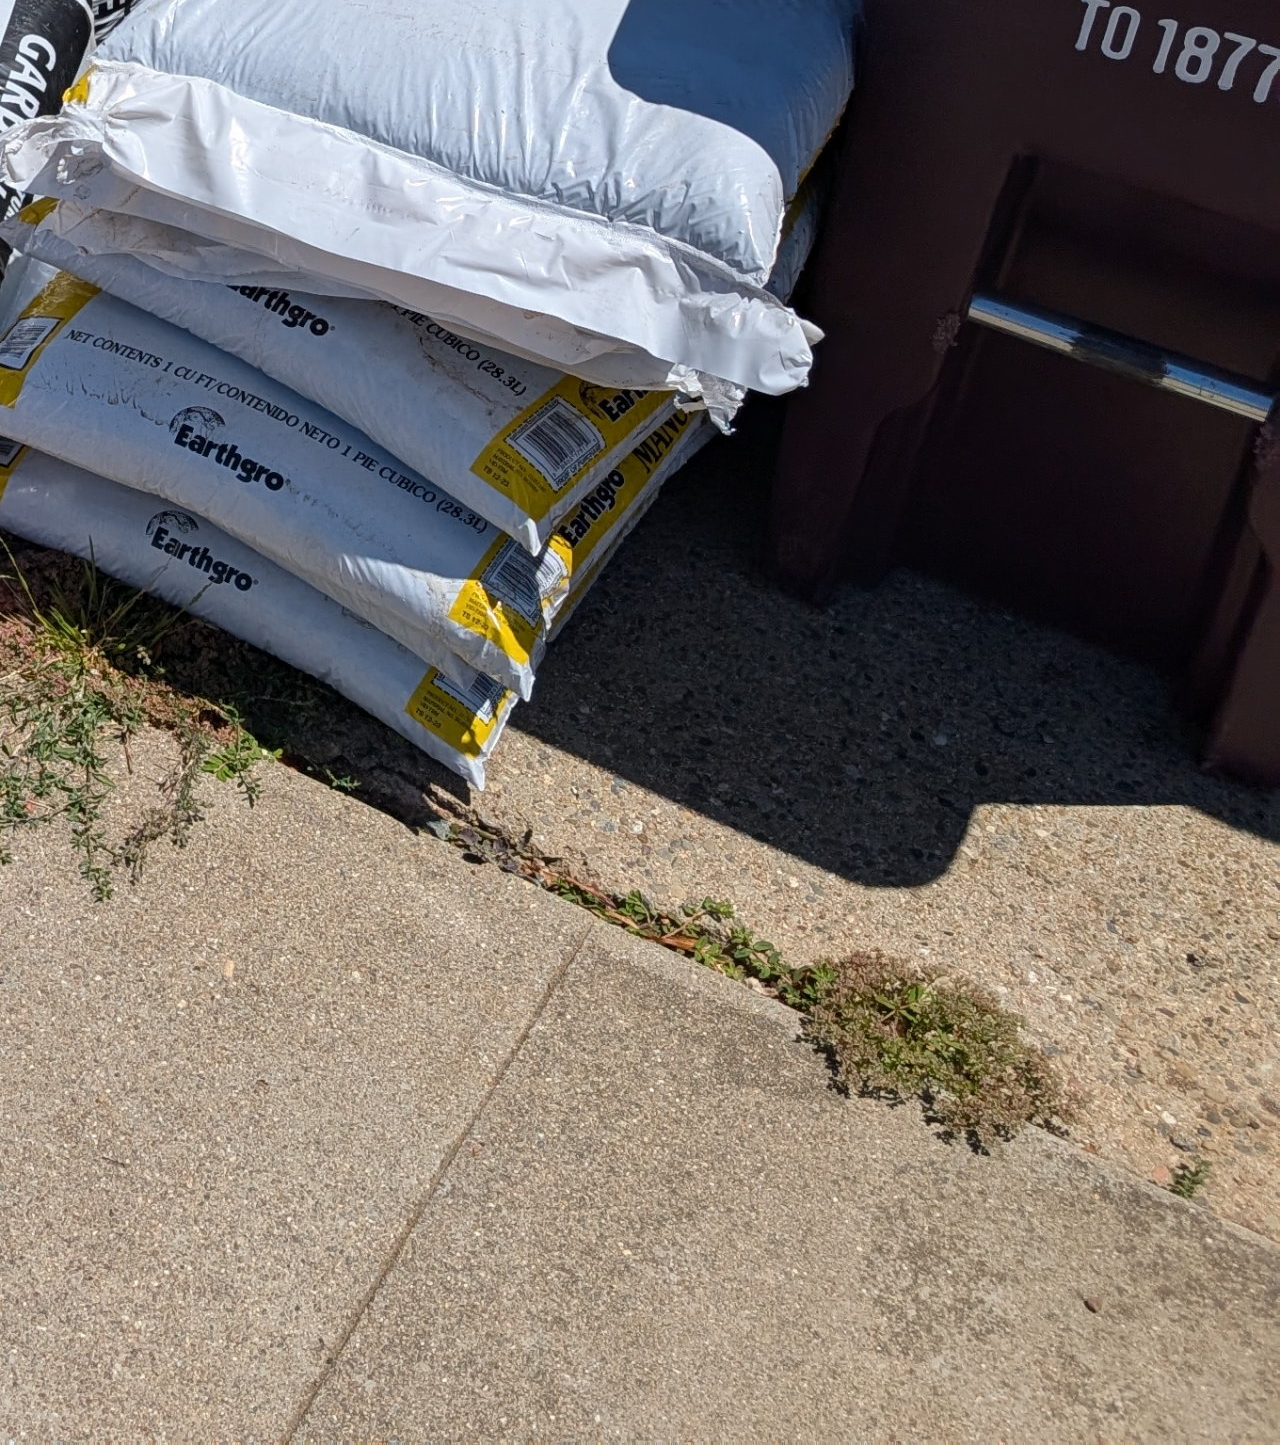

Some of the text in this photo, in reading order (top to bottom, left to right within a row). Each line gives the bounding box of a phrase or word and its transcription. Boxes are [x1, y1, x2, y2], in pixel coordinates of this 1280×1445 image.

[1152, 19, 1280, 103] 1877
[226, 285, 329, 336] arthgro
[401, 307, 528, 396] PIE CUBICO (28.3L)
[66, 329, 489, 534] NET CONTENTS 1 CU FT/CONTENIDO NETO 1 PIE CUBICO (28.3L)
[174, 424, 284, 491] Earthgro
[558, 468, 625, 550] Earthgro
[151, 526, 252, 591] Earthgro
